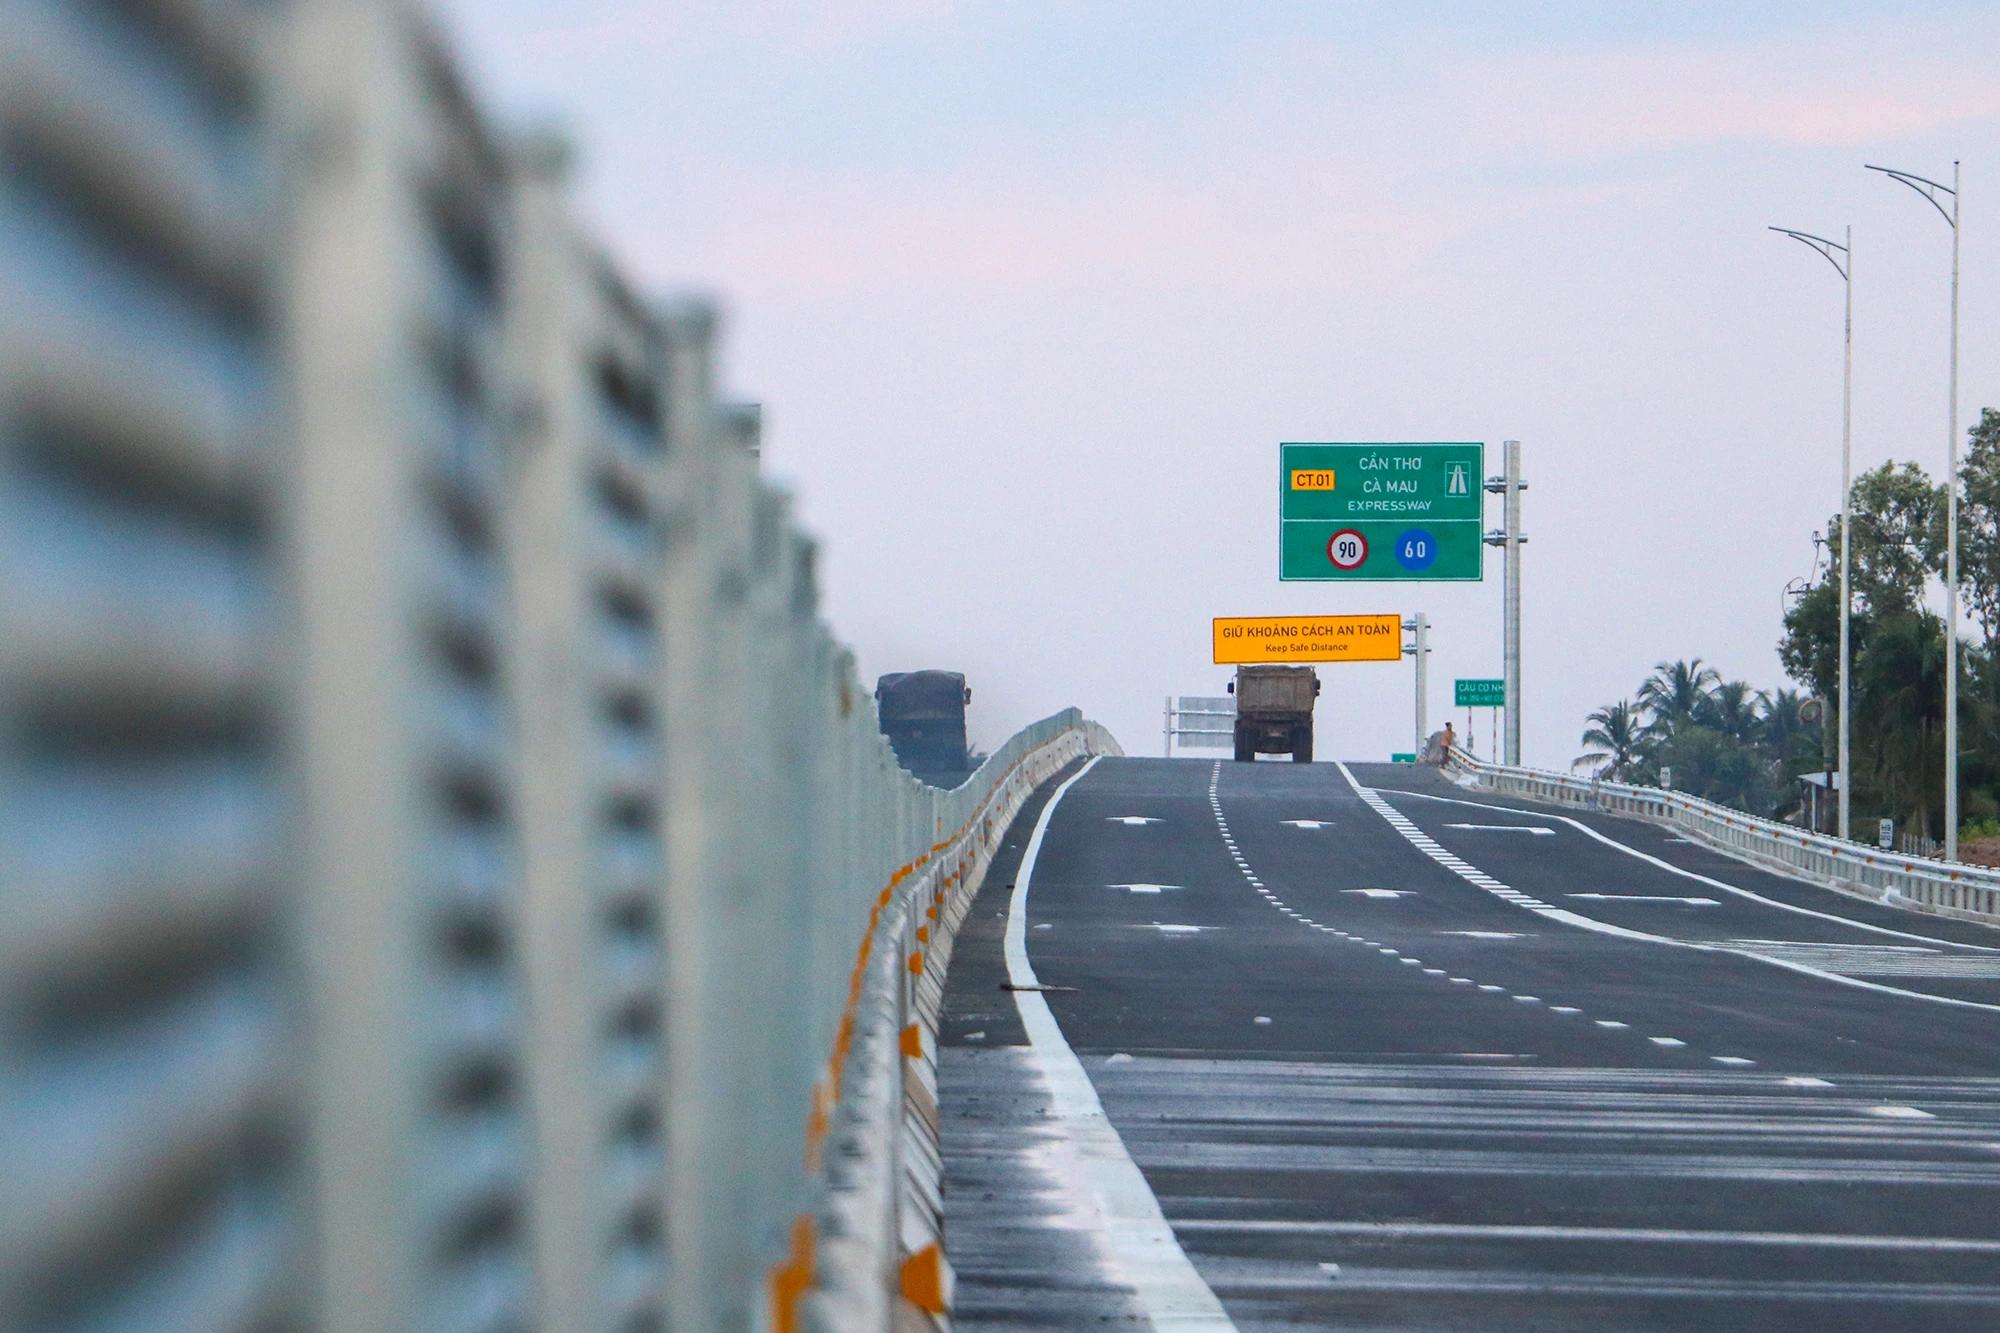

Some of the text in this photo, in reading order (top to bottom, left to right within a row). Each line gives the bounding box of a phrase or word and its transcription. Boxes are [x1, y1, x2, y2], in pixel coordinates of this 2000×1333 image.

[1359, 452, 1422, 470] CẦN THƠ
[1296, 474, 1330, 487] CT.01
[1363, 477, 1417, 493] CÀ MAU
[1348, 501, 1432, 511] EXPRESSWAY
[1339, 541, 1356, 558] 90
[1404, 541, 1426, 558] 60
[1223, 623, 1390, 638] GIỮ KHOẢNG CÁCH AN TOÀN
[1265, 643, 1348, 653] Keep Safe Distance
